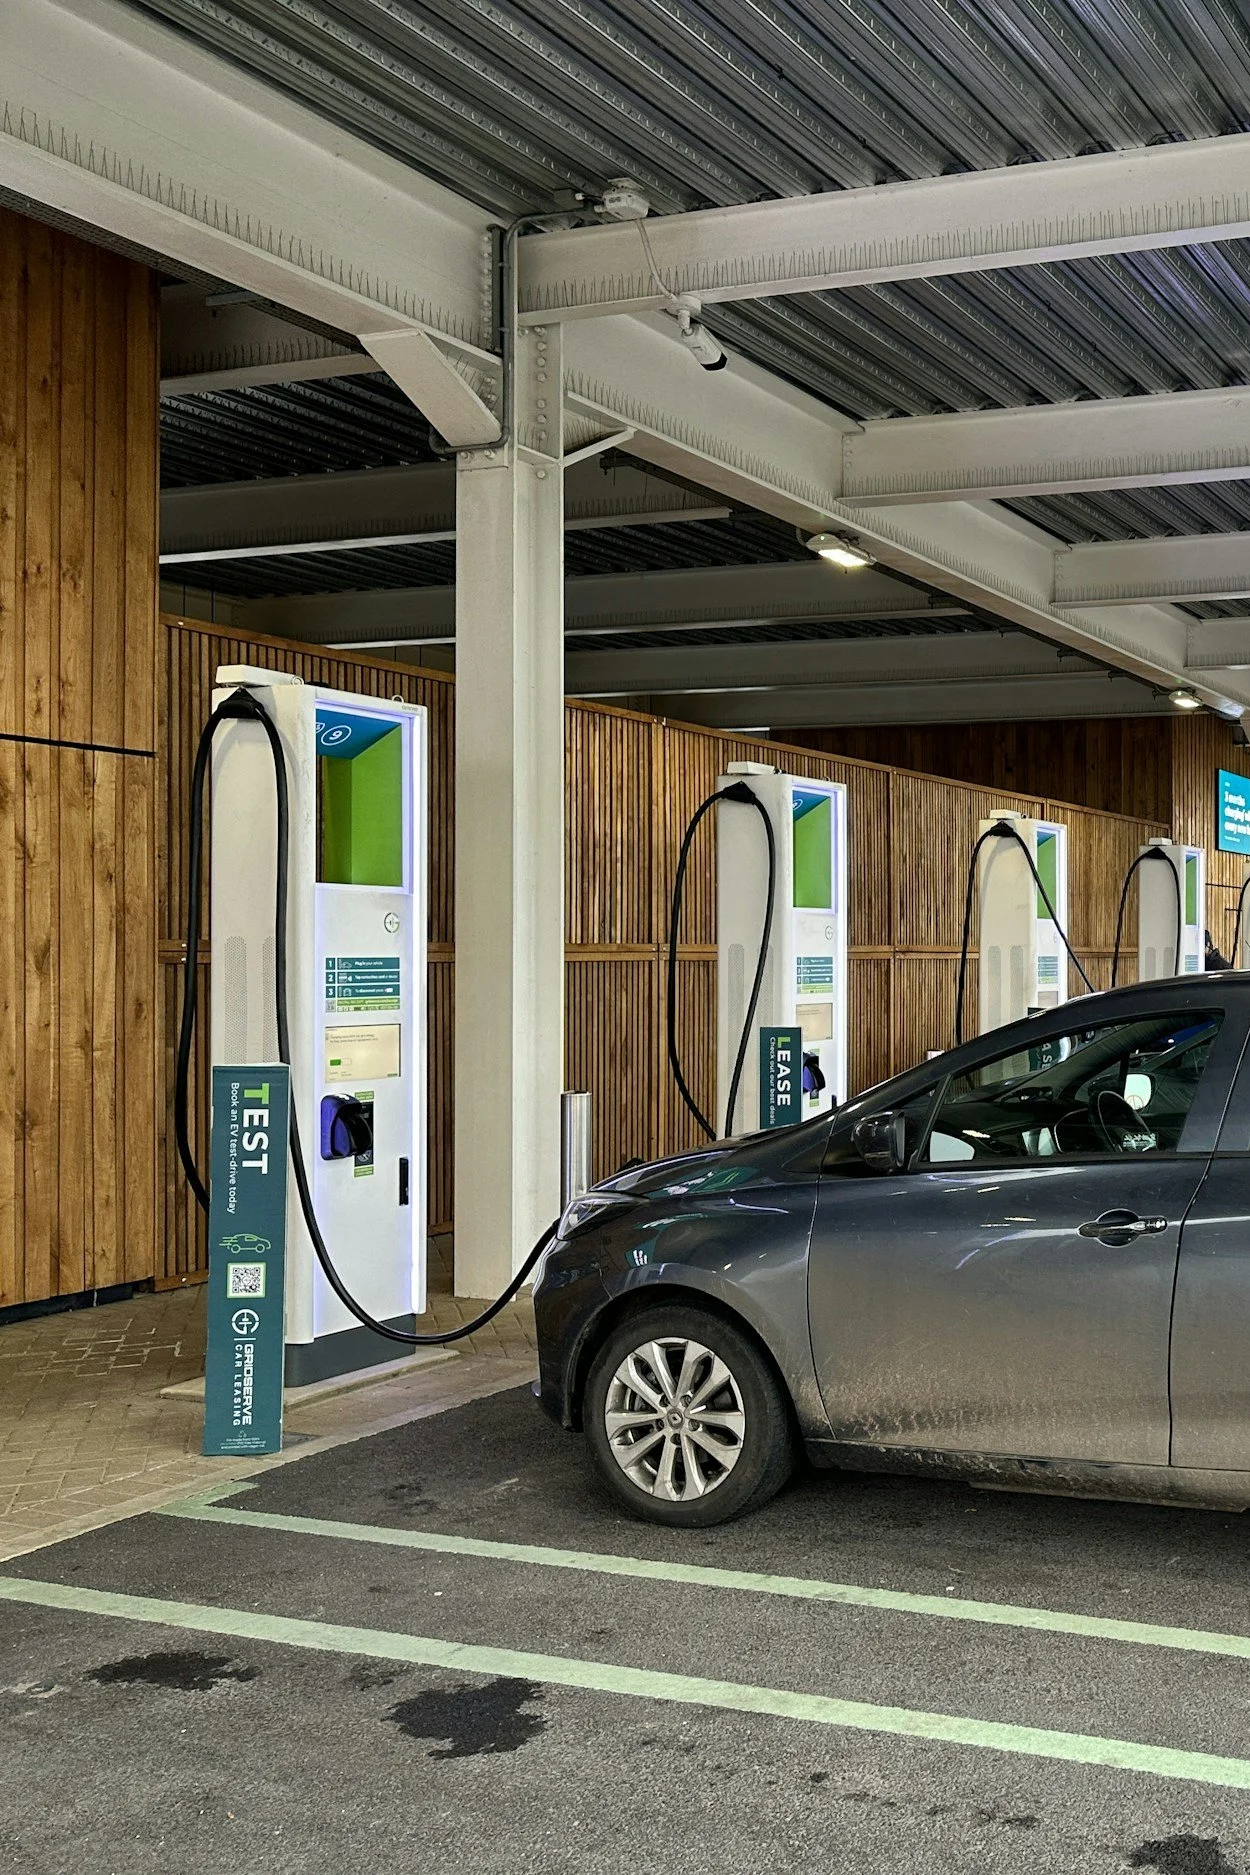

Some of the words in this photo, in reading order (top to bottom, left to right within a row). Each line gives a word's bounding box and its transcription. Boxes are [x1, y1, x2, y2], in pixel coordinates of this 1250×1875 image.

[776, 1036, 791, 1106] LEASE
[230, 1082, 240, 1107] Book
[229, 1123, 239, 1137] EV
[230, 1108, 238, 1121] an
[242, 1082, 270, 1175] TEST
[228, 1138, 238, 1185] test-drive
[226, 1186, 238, 1214] today
[234, 1344, 243, 1368] CAR
[232, 1374, 242, 1426] LEASING
[242, 1343, 254, 1426] GRIDSERVE
